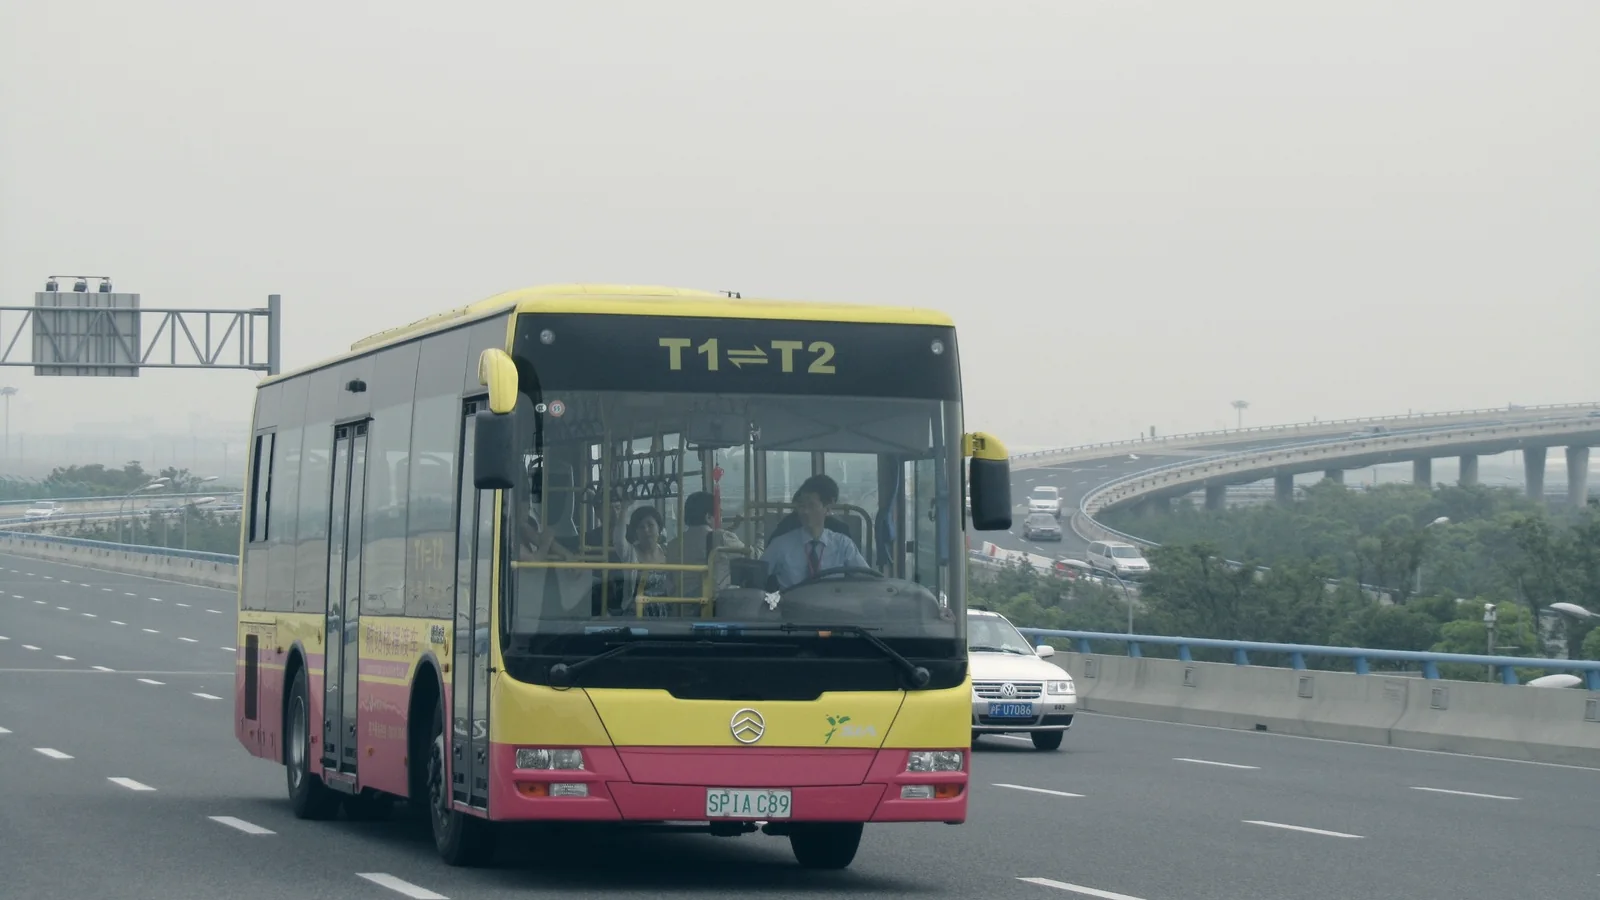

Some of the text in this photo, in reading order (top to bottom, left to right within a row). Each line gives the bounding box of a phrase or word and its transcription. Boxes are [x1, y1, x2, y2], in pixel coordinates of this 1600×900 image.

[659, 338, 836, 374] T1 T2
[708, 793, 790, 814] SPIA C89
